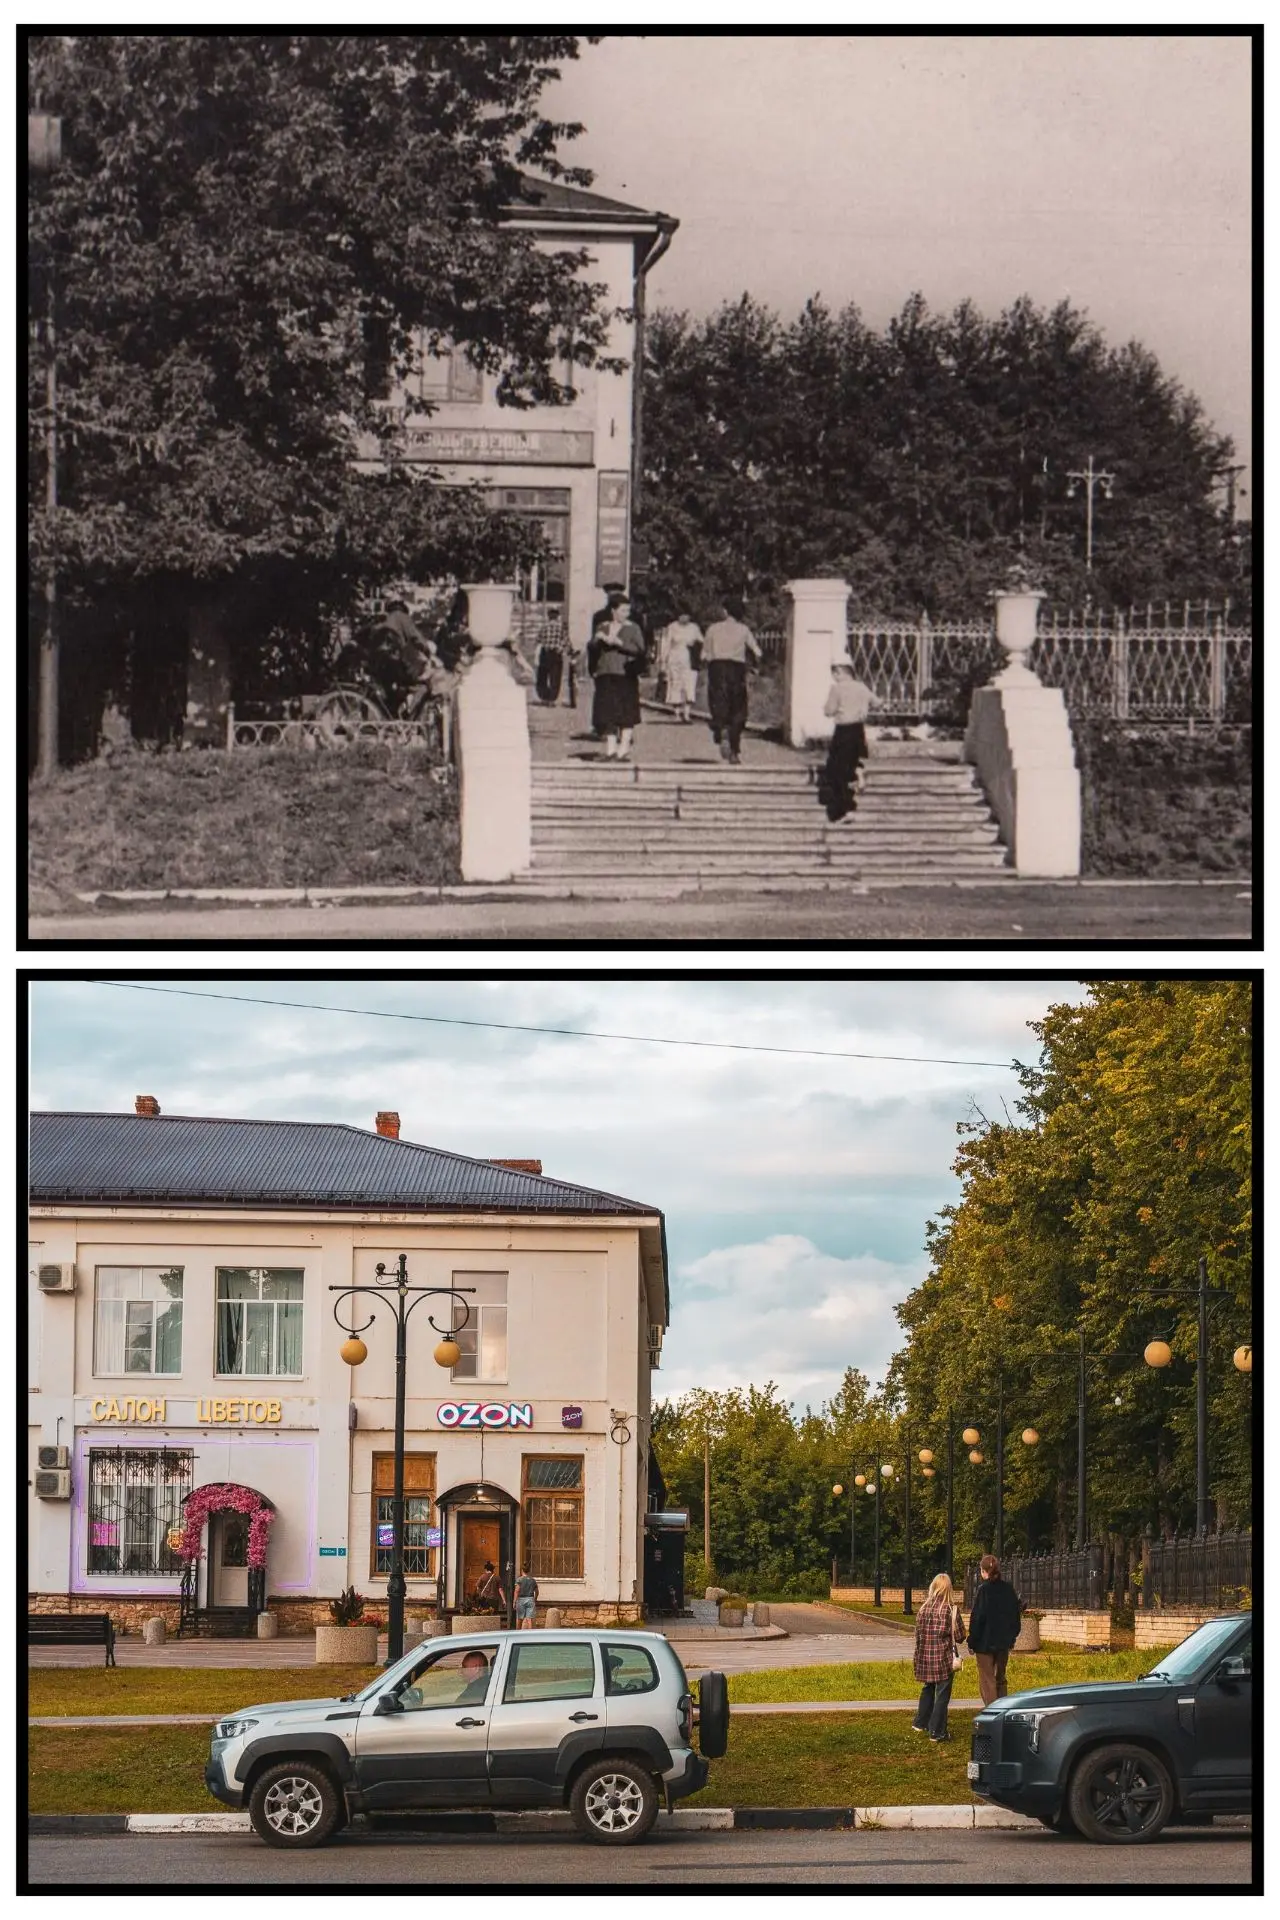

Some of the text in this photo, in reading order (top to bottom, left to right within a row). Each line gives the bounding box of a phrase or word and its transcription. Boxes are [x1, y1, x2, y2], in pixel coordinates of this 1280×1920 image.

[91, 1396, 282, 1425] САЛОН ЦВЕТОВ
[437, 1403, 533, 1428] OZON
[561, 1411, 583, 1422] OZON
